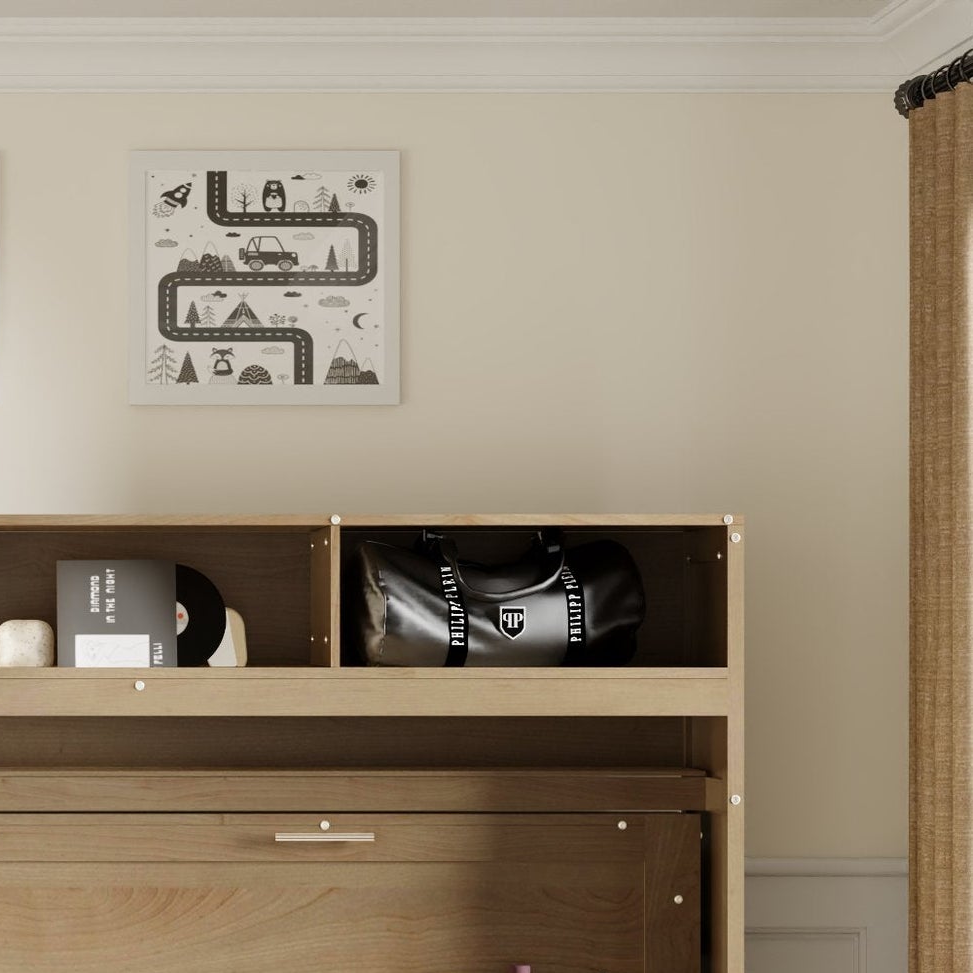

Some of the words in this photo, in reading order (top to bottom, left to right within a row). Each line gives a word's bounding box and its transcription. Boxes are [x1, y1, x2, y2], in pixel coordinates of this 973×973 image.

[90, 575, 100, 613] DIAMOND
[105, 568, 116, 594] NIGHT
[440, 566, 458, 598] PLEIN
[105, 598, 116, 613] THE
[105, 615, 116, 624] IN
[568, 593, 582, 642] PHILIPP
